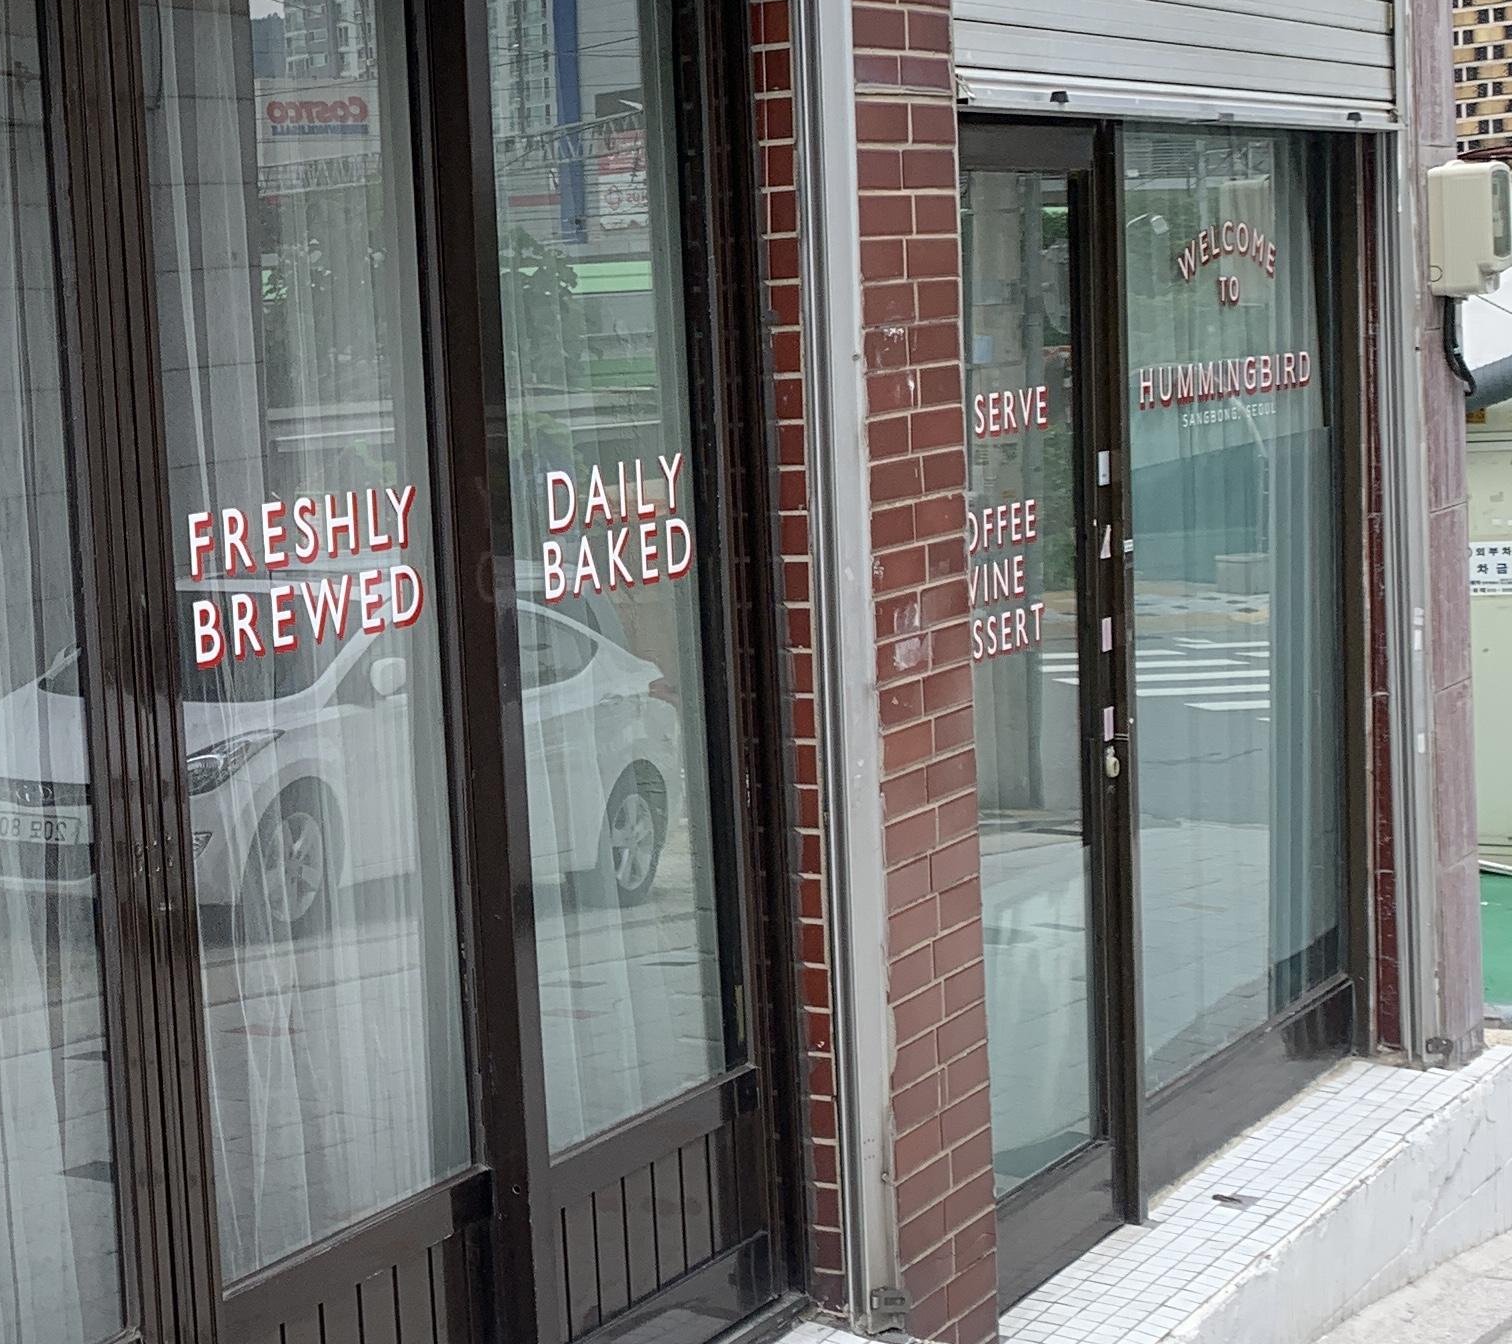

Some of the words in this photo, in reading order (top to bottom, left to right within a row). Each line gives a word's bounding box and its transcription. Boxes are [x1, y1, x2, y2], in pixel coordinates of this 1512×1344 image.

[1177, 221, 1277, 280] WELCOME
[1218, 276, 1241, 305] TO
[974, 386, 1049, 439] SERVE
[1139, 351, 1311, 410] HUMMINGBIRD
[547, 453, 684, 534] DAILY
[187, 485, 416, 580] FRESHLY
[542, 518, 694, 604] BAKED
[193, 565, 423, 669] BREWED
